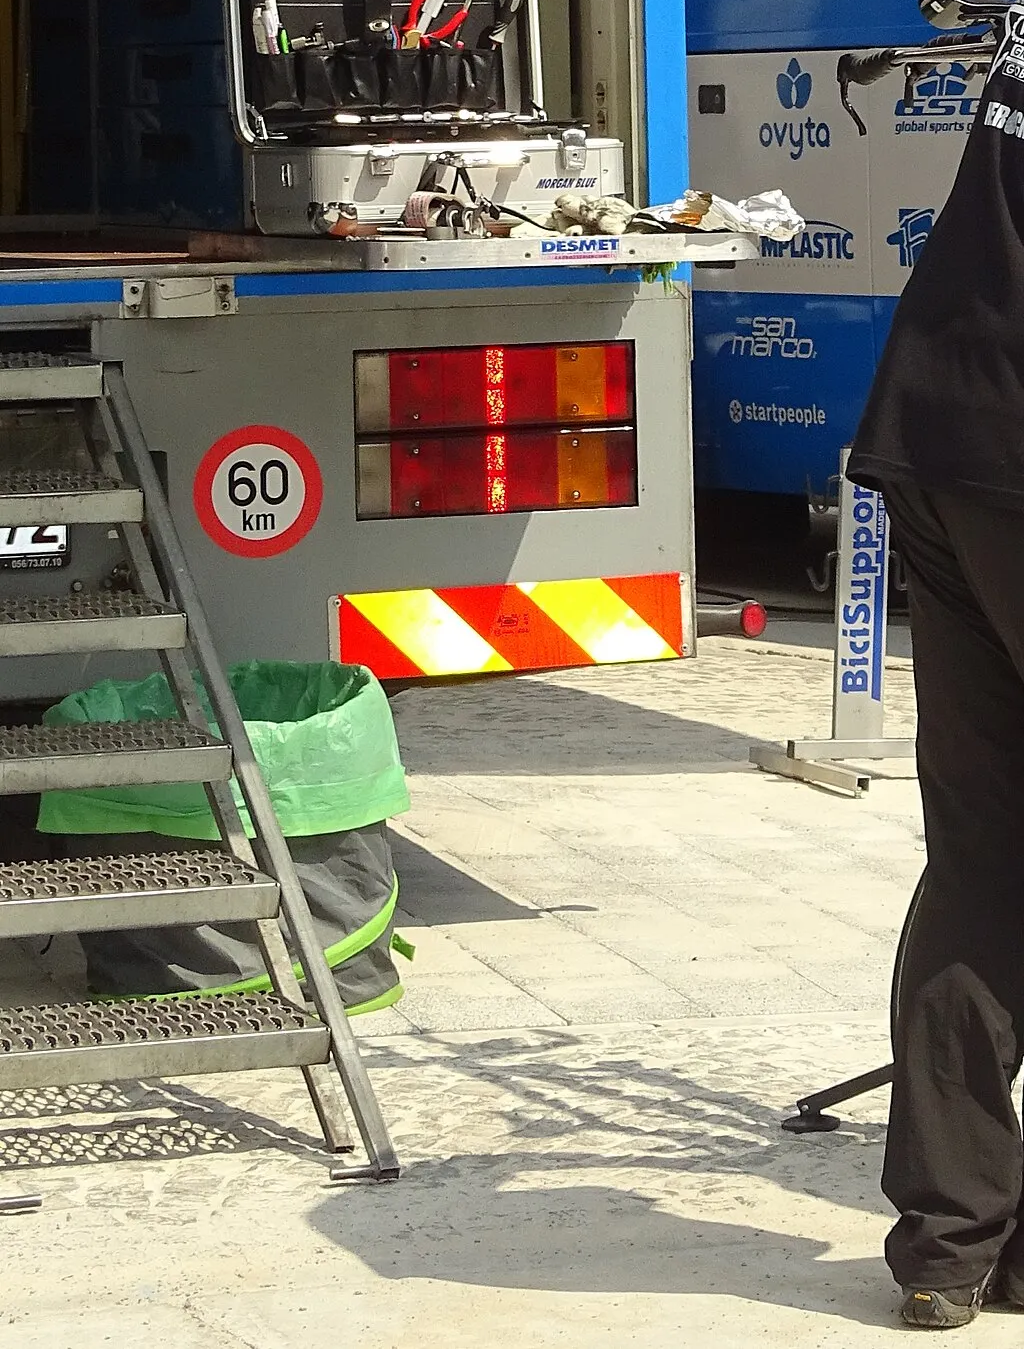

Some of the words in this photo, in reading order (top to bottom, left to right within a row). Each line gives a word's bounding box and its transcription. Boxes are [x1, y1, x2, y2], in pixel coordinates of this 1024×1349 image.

[759, 116, 830, 160] ovyta
[895, 121, 927, 134] global
[929, 121, 964, 134] sports
[536, 178, 575, 189] MORGAN
[575, 177, 597, 188] BLUE
[541, 239, 619, 252] DESMET
[752, 316, 796, 337] san
[732, 336, 814, 358] marco
[745, 403, 826, 427] startpeople
[227, 460, 288, 507] 60
[242, 508, 276, 533] km
[877, 512, 885, 535] MADE
